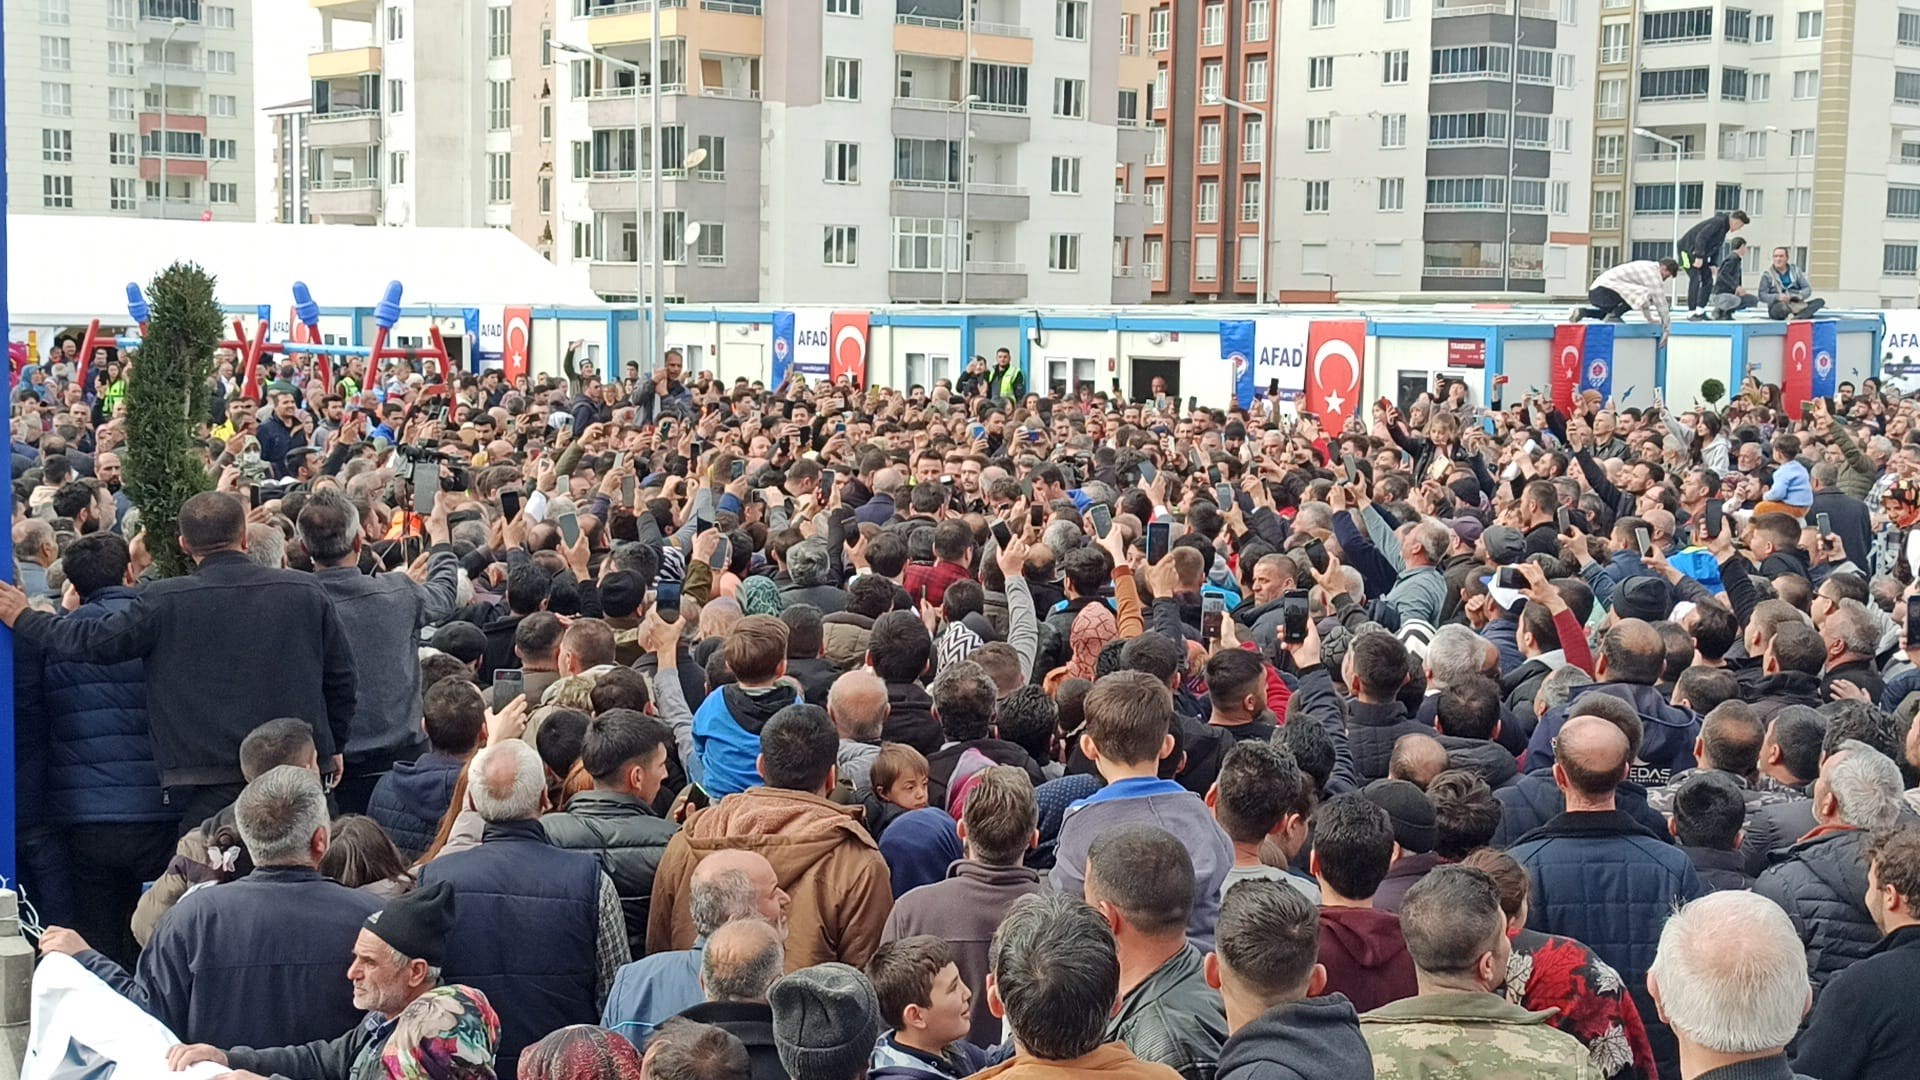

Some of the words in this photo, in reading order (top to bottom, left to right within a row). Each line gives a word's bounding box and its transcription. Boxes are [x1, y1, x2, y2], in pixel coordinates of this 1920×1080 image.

[481, 324, 502, 337] AFAD
[798, 330, 828, 346] AFAD
[1259, 346, 1303, 367] AFAD
